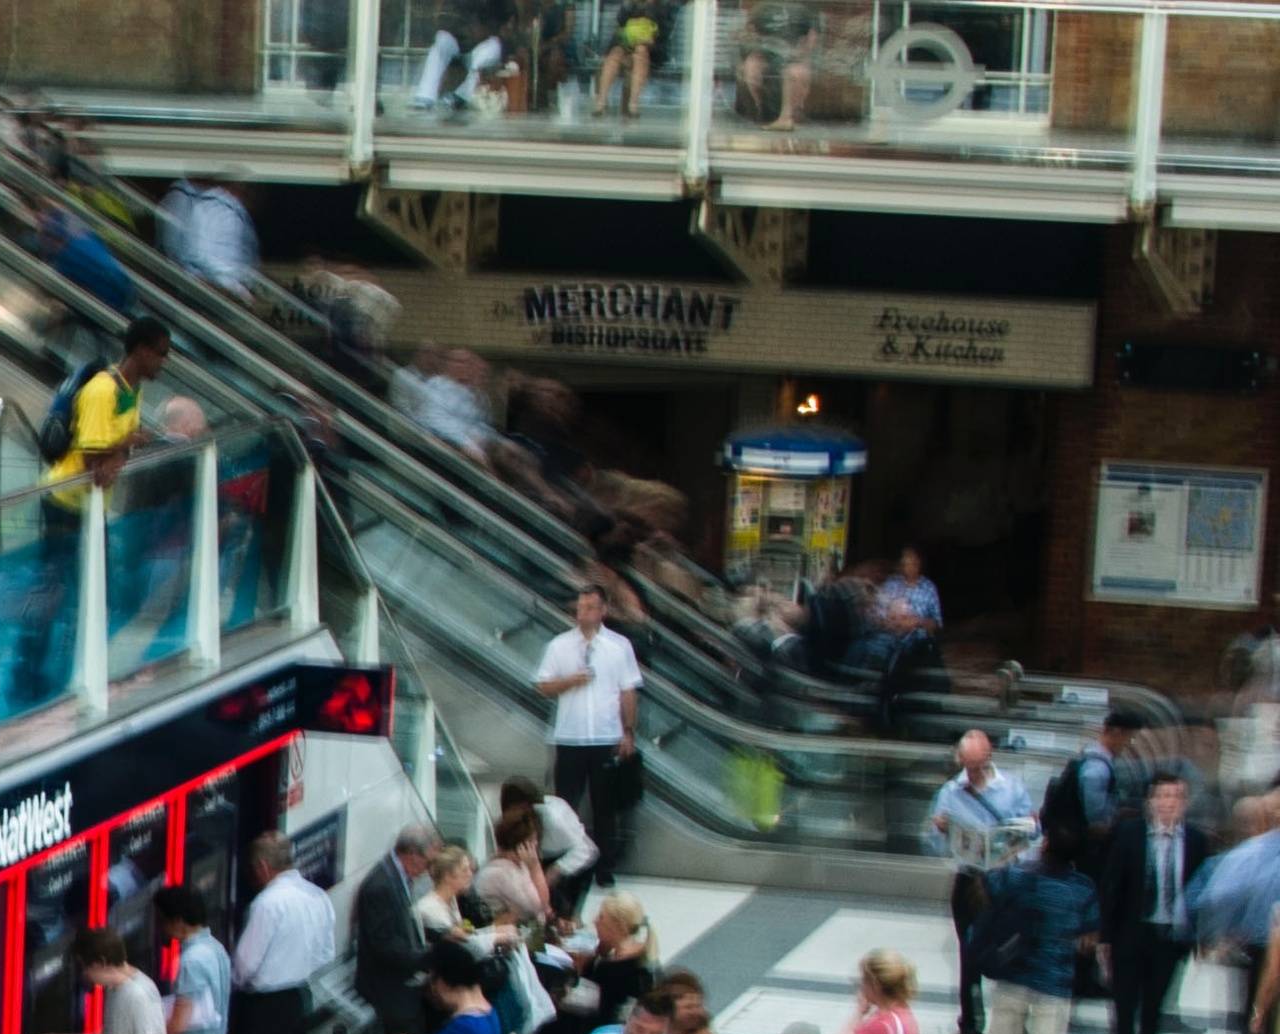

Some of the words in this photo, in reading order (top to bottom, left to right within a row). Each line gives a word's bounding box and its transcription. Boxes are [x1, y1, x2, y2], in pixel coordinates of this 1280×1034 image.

[523, 281, 741, 331] MERCHANT
[877, 306, 1012, 336] Freehouse
[550, 323, 709, 352] BISHOPSGATE
[881, 334, 899, 354] &
[911, 333, 1006, 361] Kitchen
